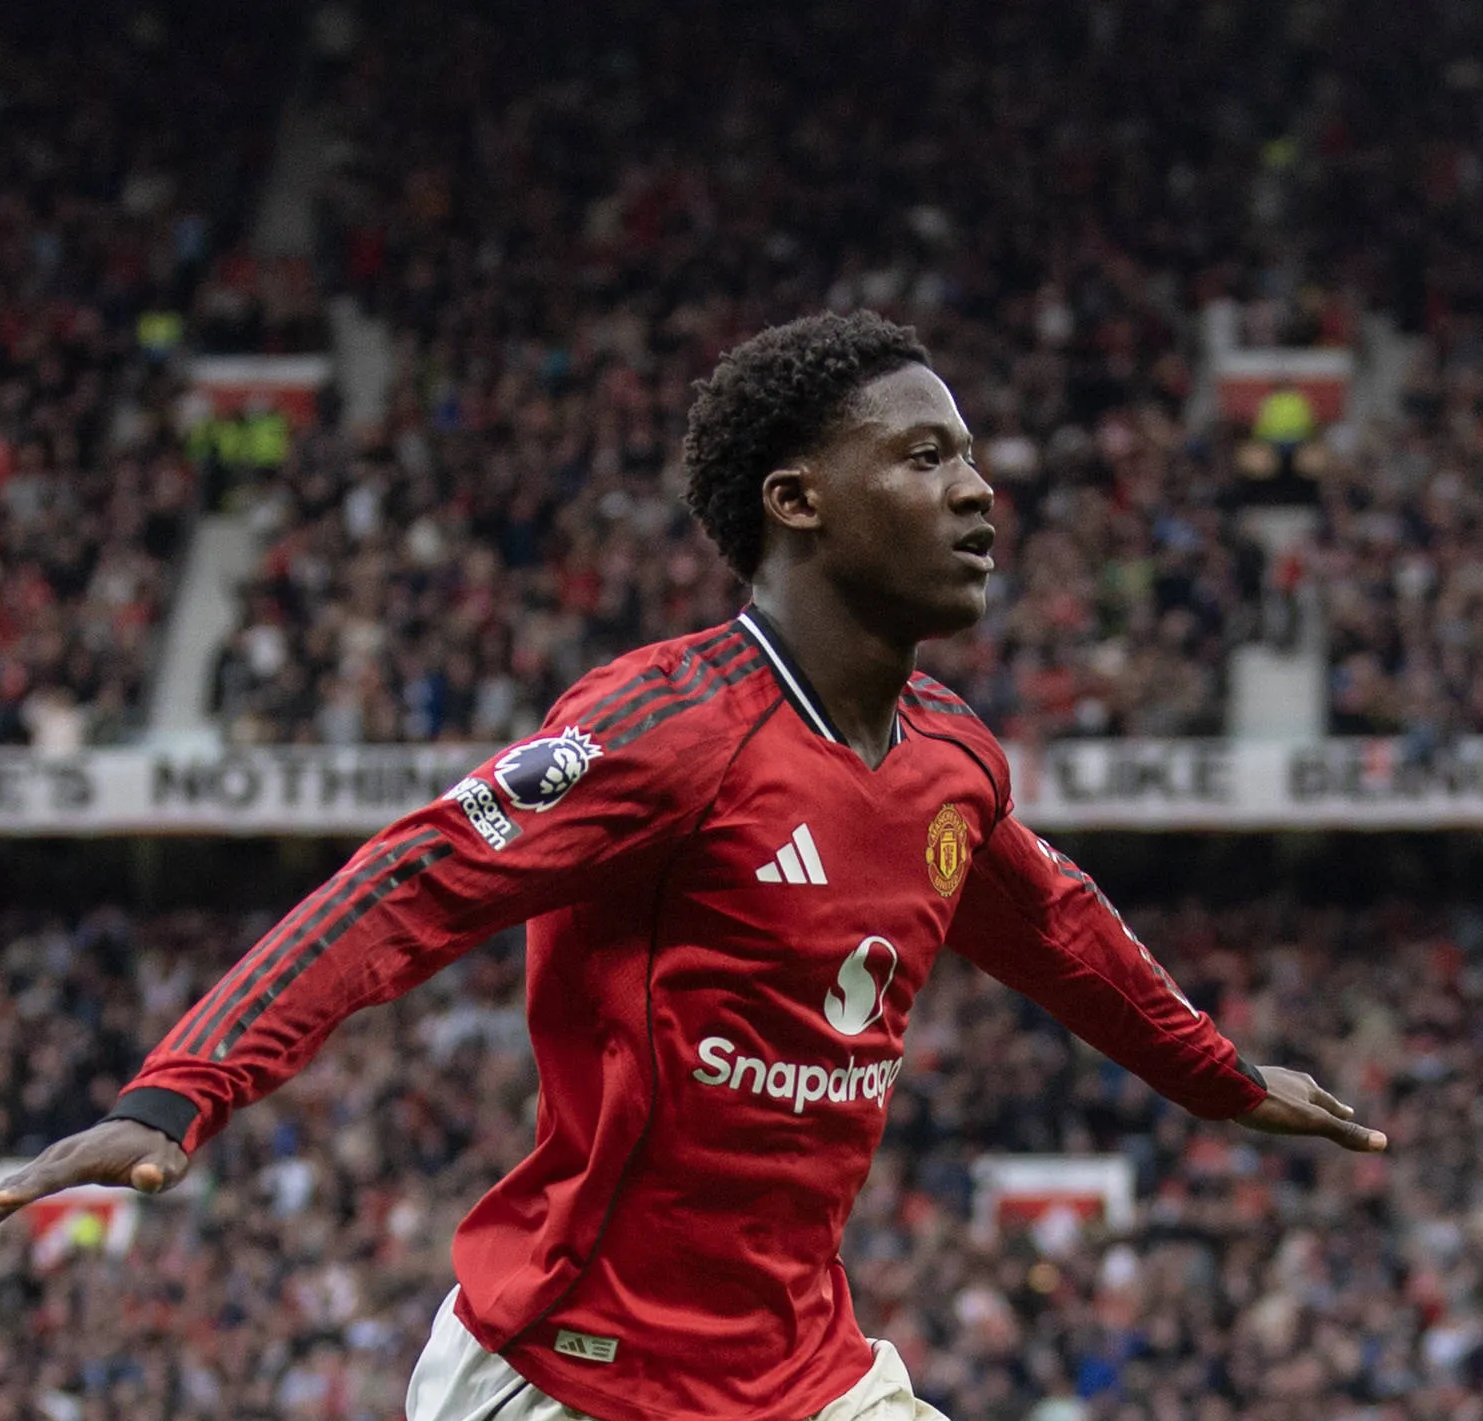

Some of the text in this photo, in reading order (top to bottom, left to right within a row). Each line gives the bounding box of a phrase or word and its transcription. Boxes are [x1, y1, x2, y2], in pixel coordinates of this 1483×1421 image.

[151, 757, 466, 812] NOTHIN
[1054, 745, 1232, 802] LIKE
[457, 791, 506, 852] racism
[471, 783, 511, 835] room
[692, 1035, 903, 1114] Snapdrago
